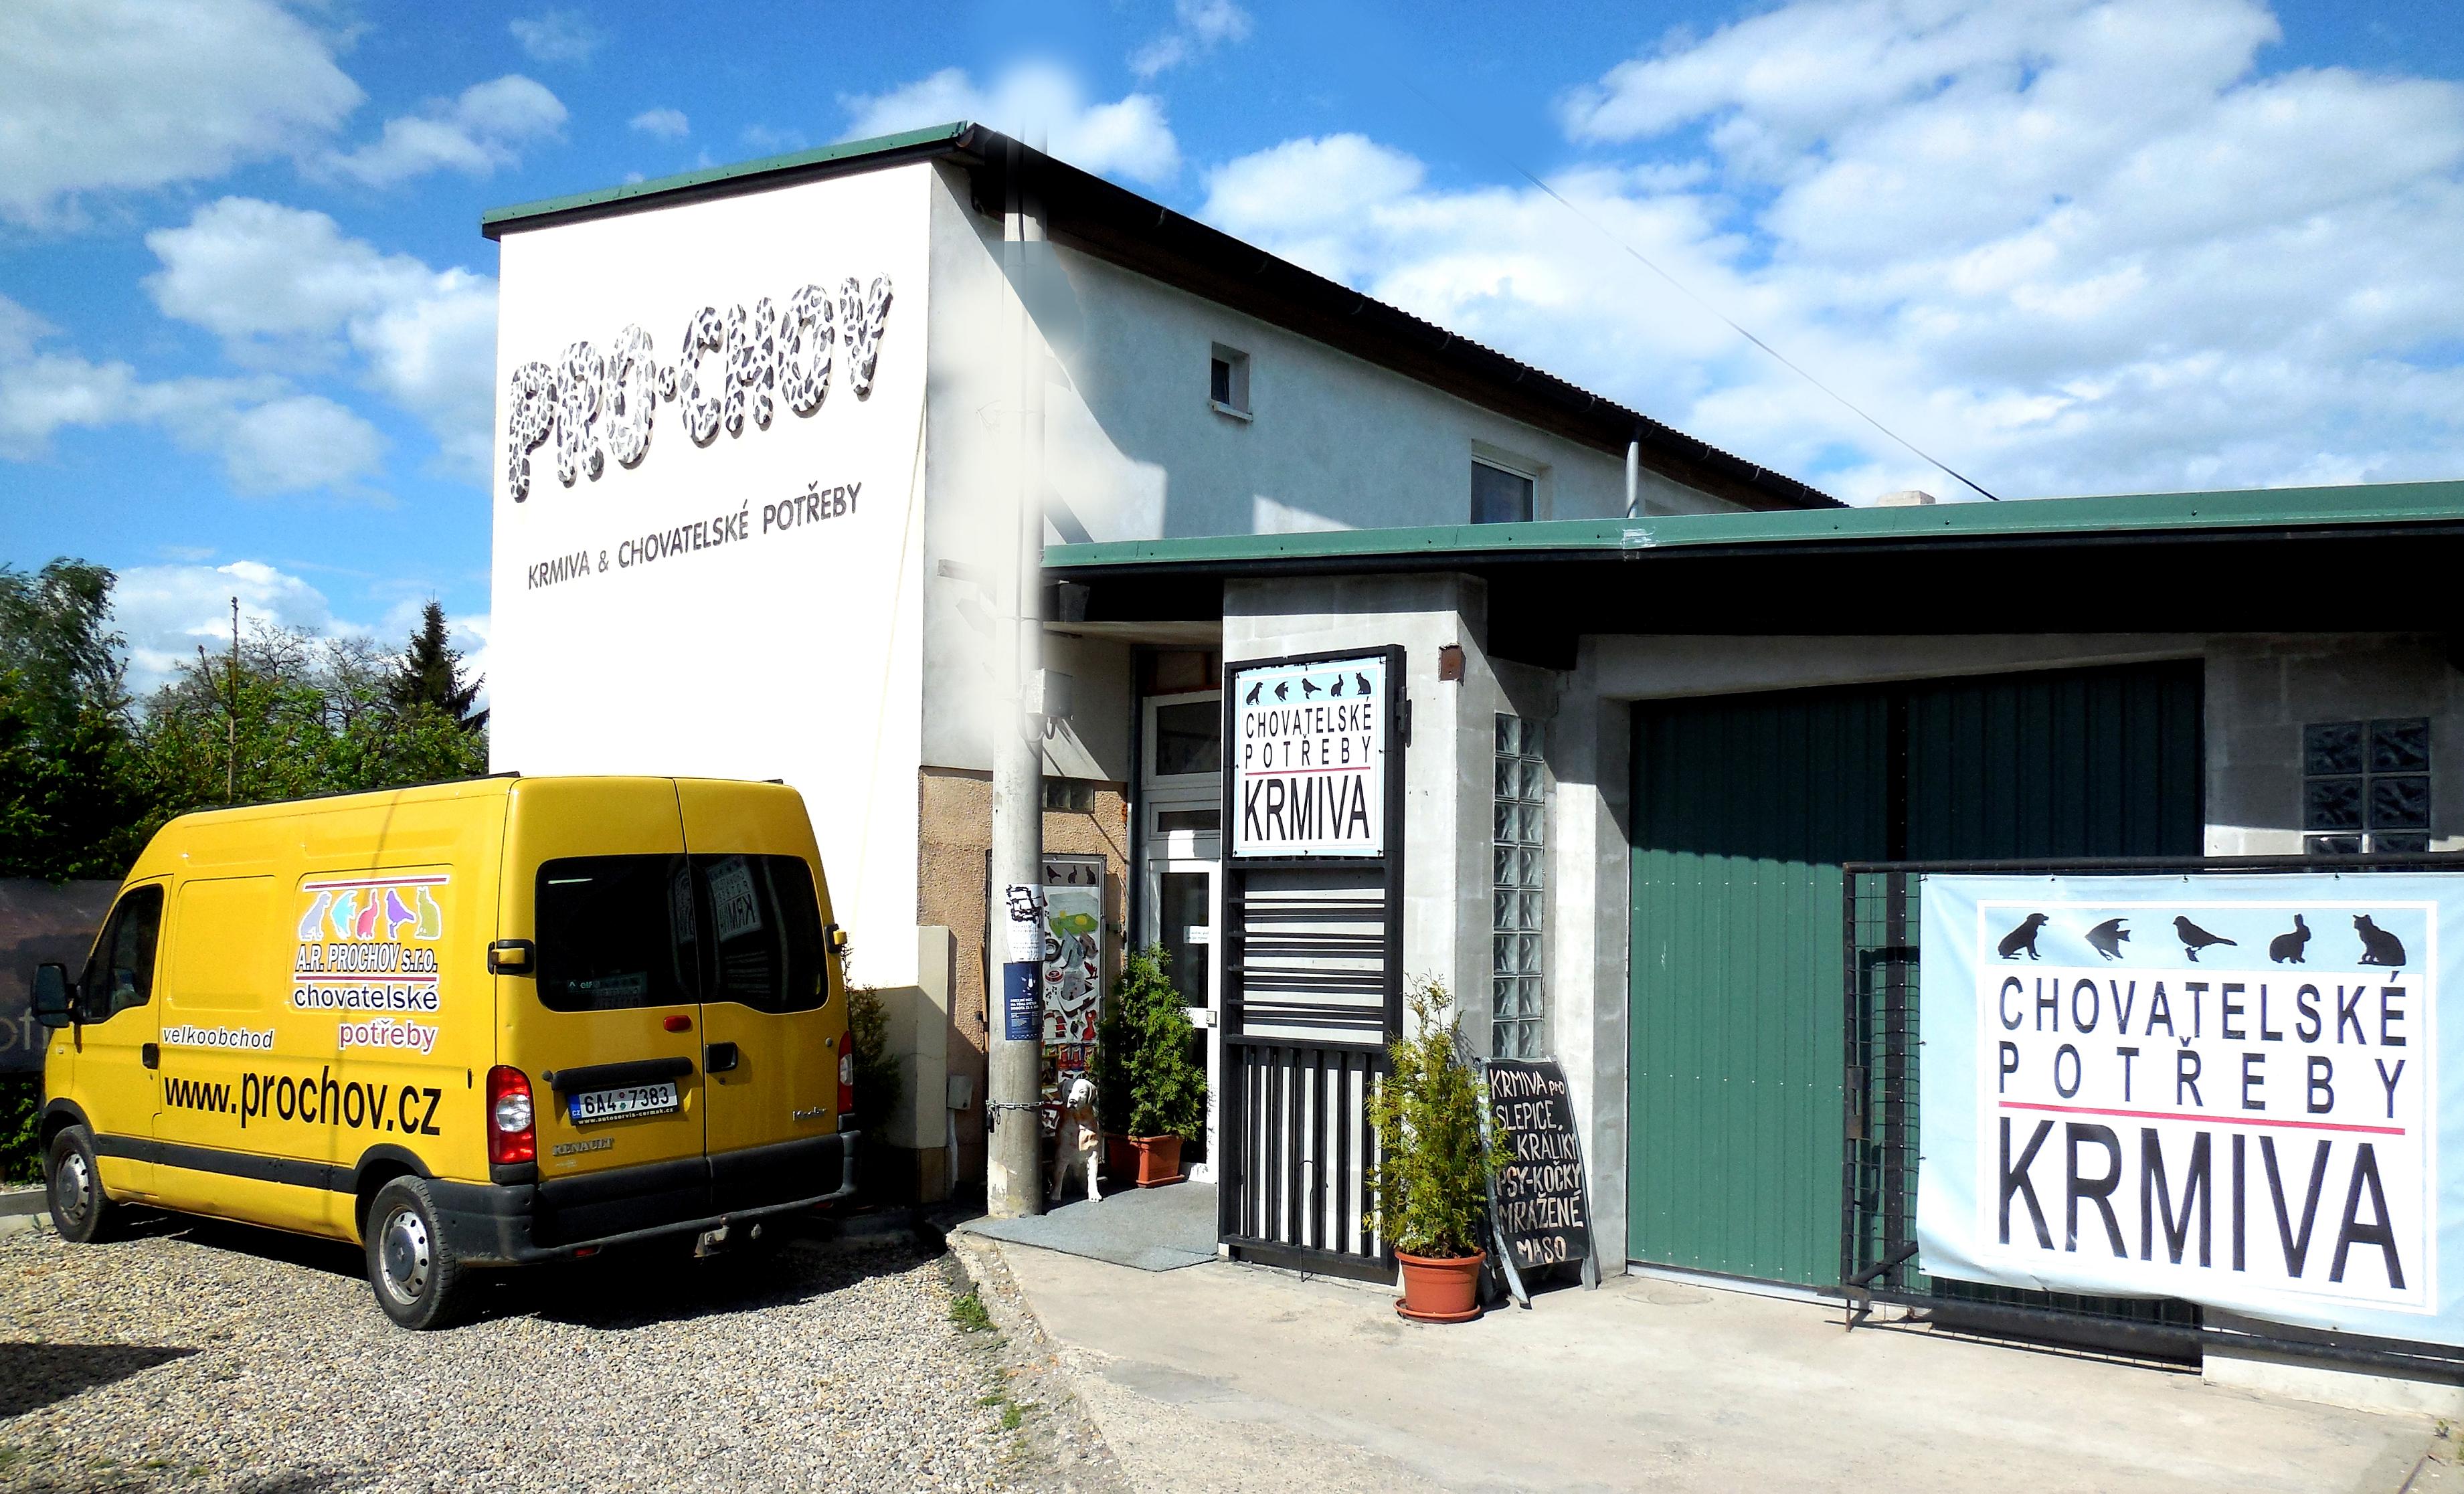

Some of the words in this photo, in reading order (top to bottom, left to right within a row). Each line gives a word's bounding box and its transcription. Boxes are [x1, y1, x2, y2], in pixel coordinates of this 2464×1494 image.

[529, 553, 590, 589] KRMIVA
[598, 550, 608, 572] &
[618, 500, 748, 568] CHOVATELSKÉ
[764, 480, 861, 534] POTŘEBY
[1246, 696, 1371, 738] CHOVATELSKÉ
[1245, 734, 1371, 769] POTŘEBY
[1245, 775, 1370, 841] KRMIVA
[296, 944, 324, 972] A.R.
[327, 943, 400, 973] PROCHOV
[402, 949, 437, 973] s.r.o.
[294, 984, 437, 1010] chovatelské
[1998, 971, 2406, 1046] CHOVATELSKÉ
[163, 1027, 272, 1048] velkoobchod
[341, 1019, 436, 1052] potřeby
[1490, 1068, 1547, 1100] KRMIVA
[1549, 1080, 1565, 1096] pro
[1998, 1036, 2406, 1119] POTŘEBY
[165, 1066, 442, 1135] www.prochov.cz
[578, 1108, 674, 1125] www.autoservis-cermak.cz
[584, 1093, 616, 1114] 6A4
[628, 1087, 669, 1108] 7383
[551, 1137, 614, 1156] RENAULT
[1499, 1190, 1583, 1235] MRAŽENÉ
[1998, 1117, 2406, 1290] KRMIVA
[1516, 1236, 1566, 1263] MASO
